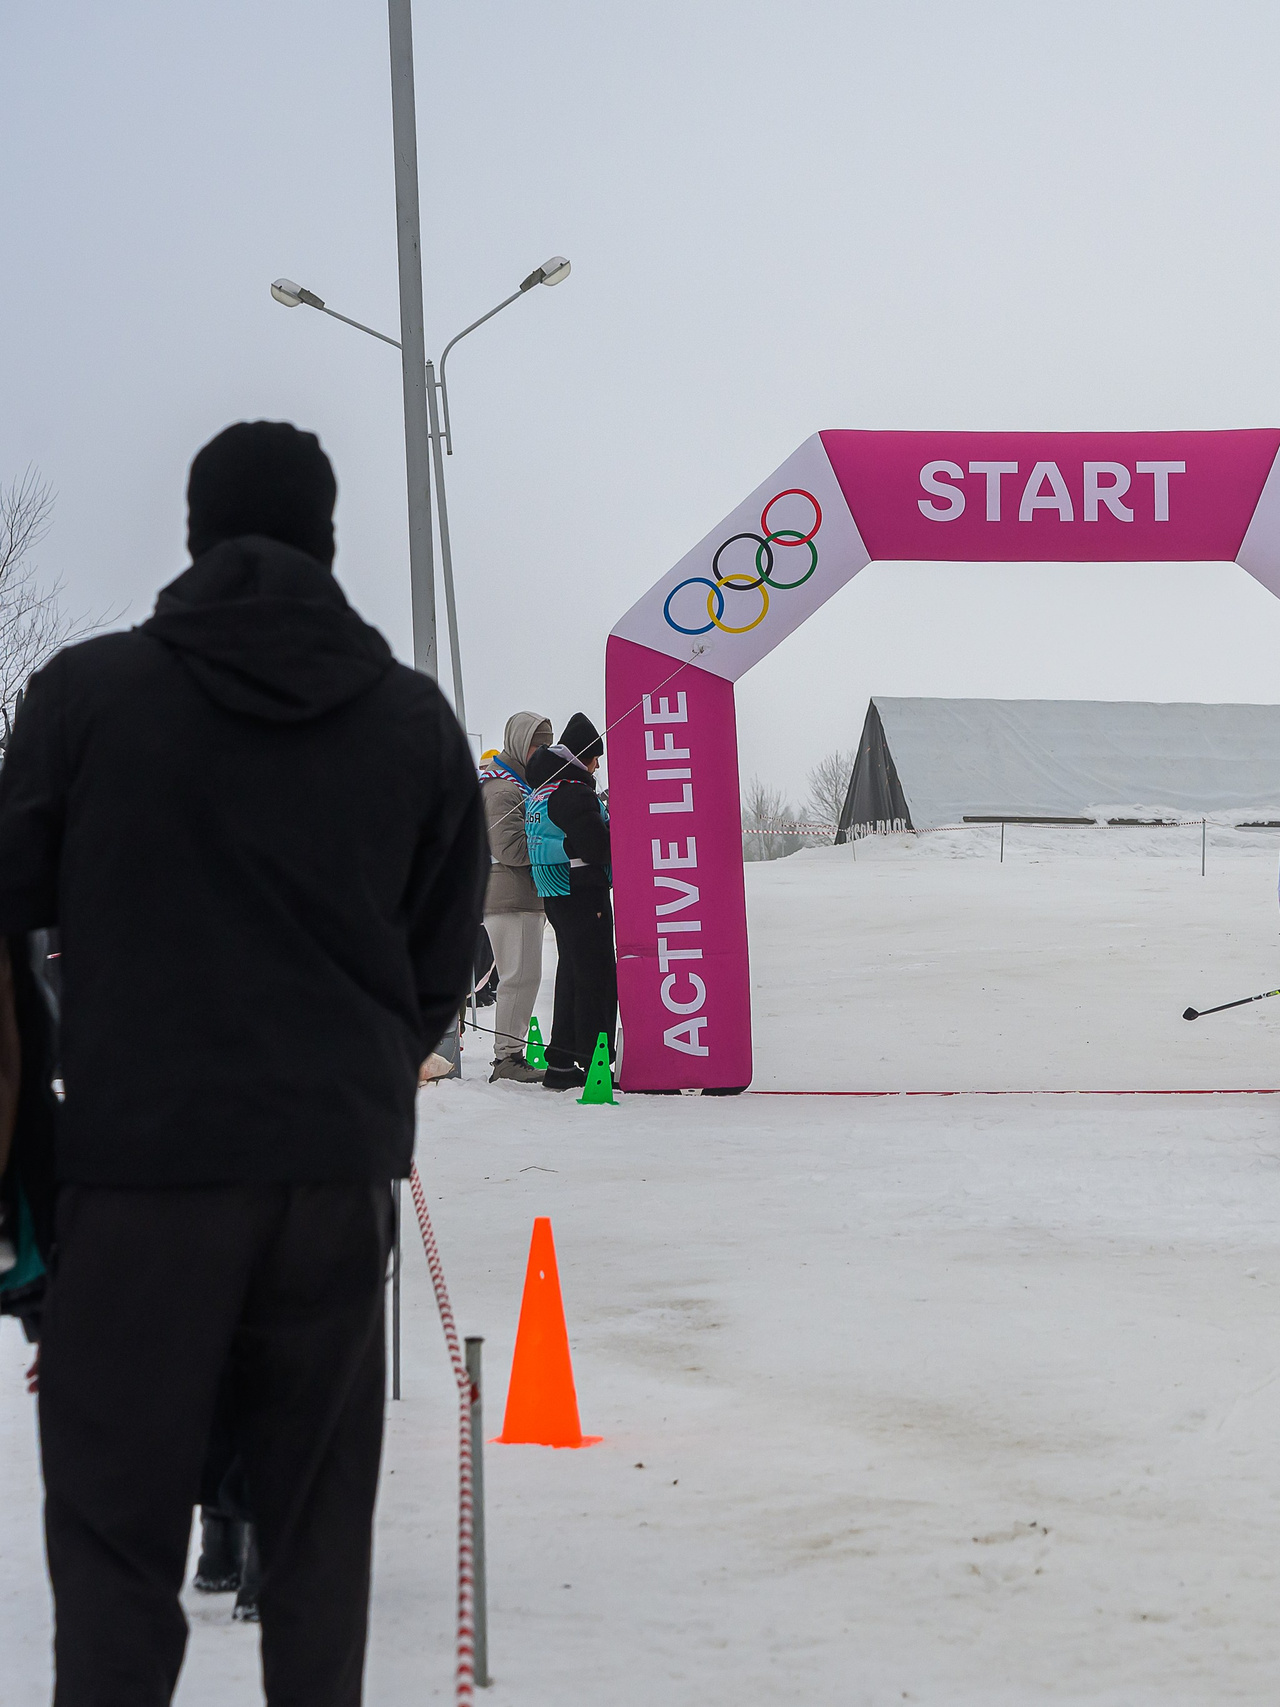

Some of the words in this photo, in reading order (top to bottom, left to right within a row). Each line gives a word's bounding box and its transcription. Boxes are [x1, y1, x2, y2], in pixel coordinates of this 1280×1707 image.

[917, 460, 1187, 523] START
[642, 690, 694, 814] LIFE
[651, 836, 709, 1058] ACTIVE
